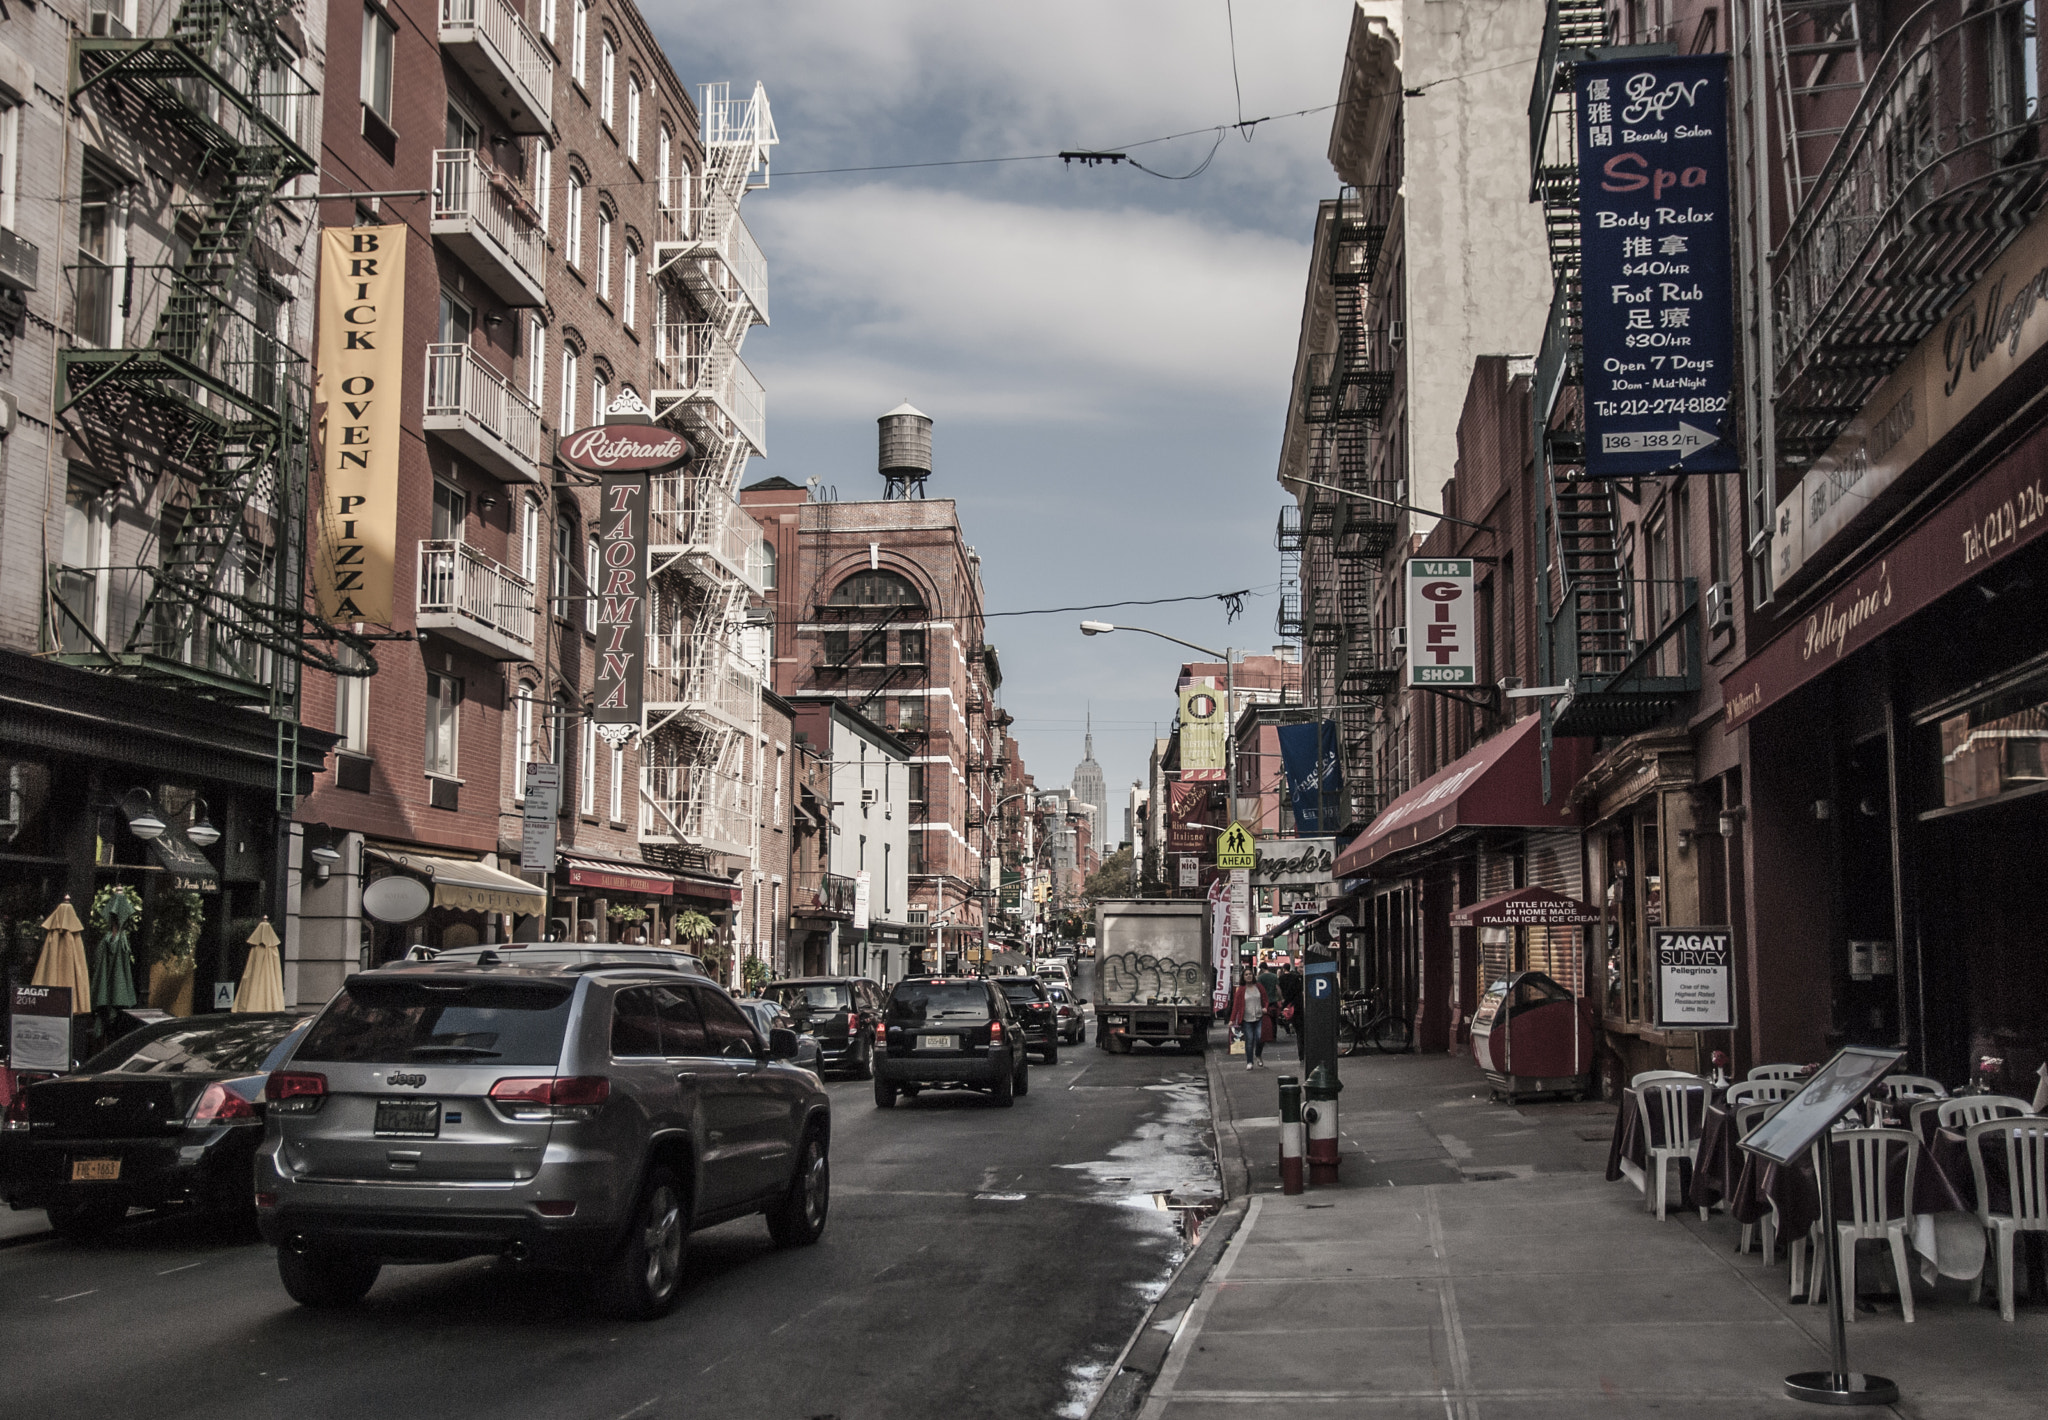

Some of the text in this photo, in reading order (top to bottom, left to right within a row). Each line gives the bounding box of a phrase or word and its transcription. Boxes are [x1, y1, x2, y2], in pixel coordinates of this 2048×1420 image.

[1621, 125, 1713, 143] Beauty Salon
[1601, 152, 1707, 200] Spa
[1595, 207, 1714, 229] Body Relax
[1623, 235, 1688, 258] 推拿
[1622, 262, 1690, 275] $40/HR
[1612, 282, 1703, 304] Foot Rub
[1625, 307, 1690, 330] 足療
[1625, 333, 1691, 348] $30/HR
[1603, 355, 1714, 374] Open 7 Days
[1611, 379, 1642, 391] 10am
[1652, 377, 1707, 391] Mid-Night
[1594, 397, 1726, 416] Tel: 212-274-8182
[333, 233, 378, 618] BRICK OVEN PIZZA
[570, 428, 681, 466] Ristorante
[1605, 436, 1630, 449] 136
[1642, 435, 1668, 447] 138
[1672, 434, 1700, 446] 2/FL
[1962, 522, 1983, 564] Tel:
[1984, 499, 2016, 558] (212)
[1424, 563, 1460, 575] V.I.P.
[599, 485, 640, 710] TAORMINA
[1803, 560, 1893, 660] Pellegrino's
[1421, 581, 1462, 665] GIFT
[1422, 669, 1465, 681] SHOP
[1222, 856, 1252, 866] AHEAD
[1294, 902, 1317, 910] ATM
[1660, 935, 1727, 951] ZAGAT
[1661, 951, 1727, 965] SURVEY
[1670, 967, 1718, 976] Pellegrino's
[17, 988, 49, 997] ZAGAT
[218, 985, 230, 1000] A
[1315, 979, 1327, 997] P
[16, 996, 36, 1005] 2014
[1697, 1006, 1709, 1014] Italy
[387, 1070, 427, 1088] Jeep
